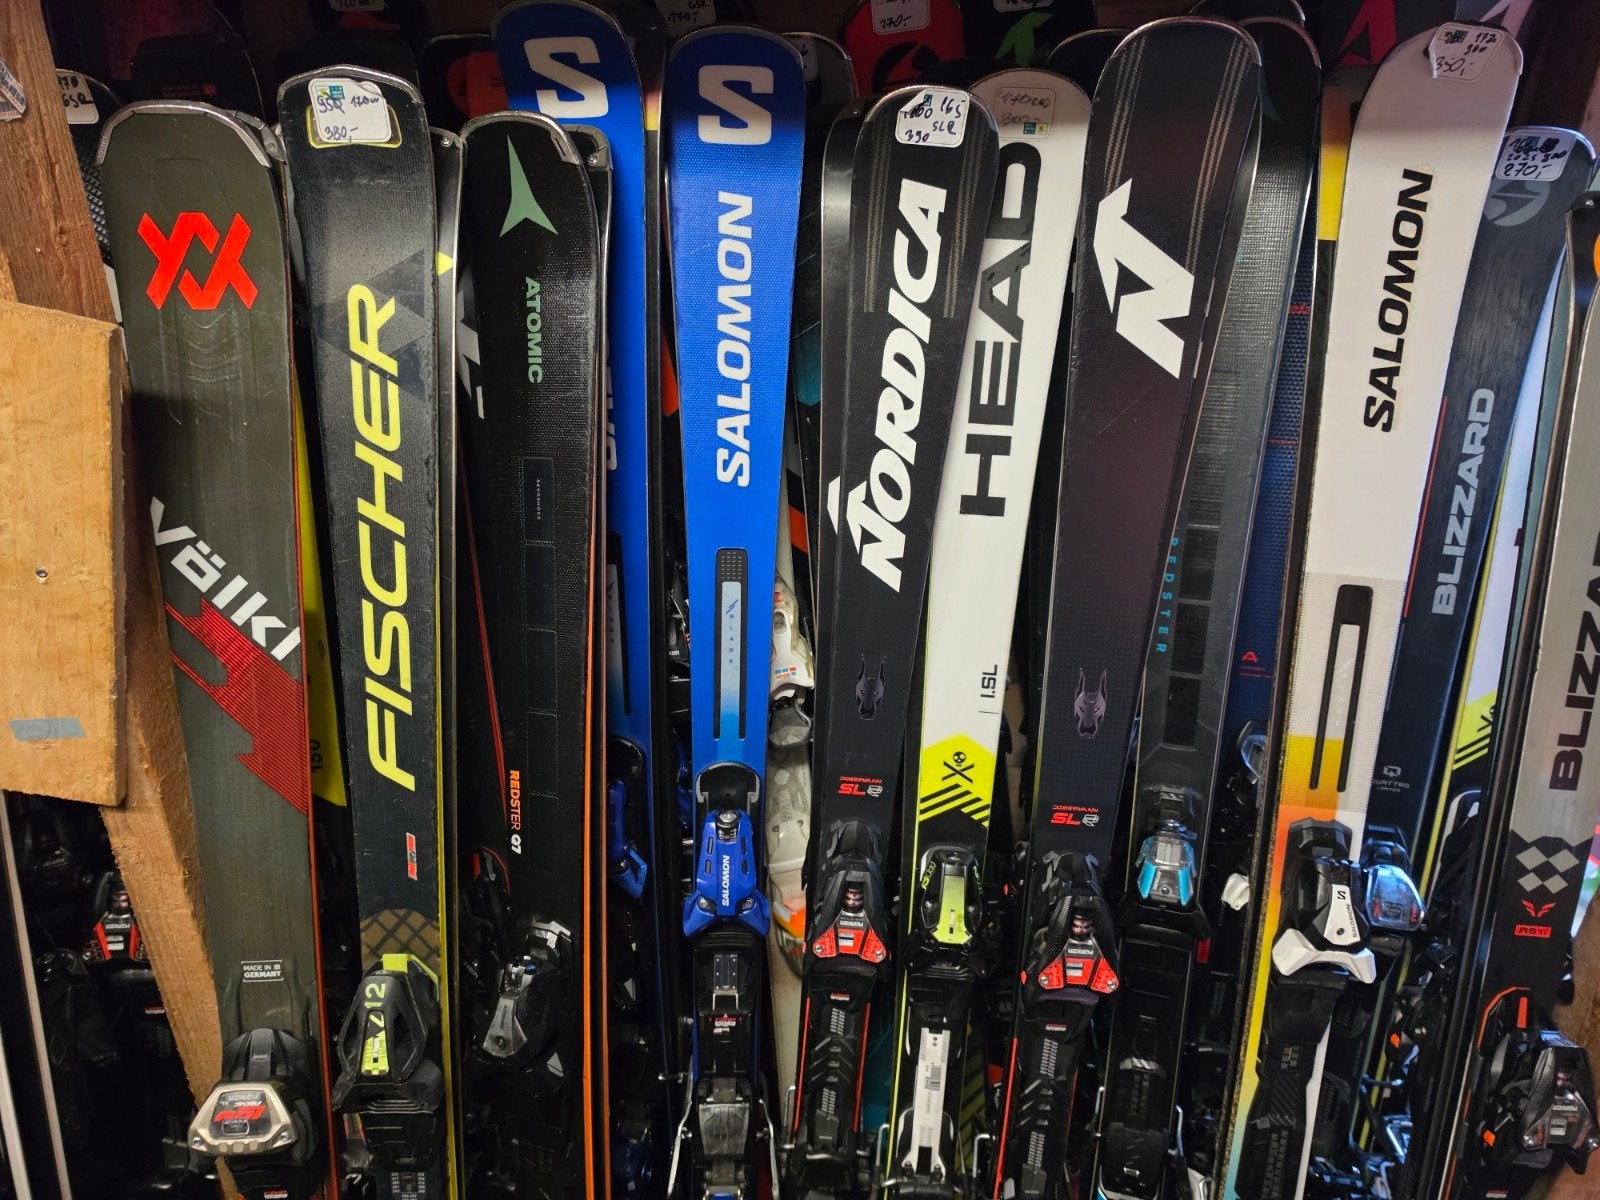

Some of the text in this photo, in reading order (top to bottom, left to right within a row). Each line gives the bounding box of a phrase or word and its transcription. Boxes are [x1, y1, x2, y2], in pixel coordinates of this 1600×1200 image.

[698, 64, 774, 145] S
[525, 276, 543, 384] ATOMIC
[716, 190, 753, 487] SALOMON
[958, 142, 1043, 517] HEAD
[1364, 168, 1434, 433] SALOMON
[846, 178, 947, 593] NORDICA
[346, 284, 417, 791] FISCHER
[1431, 388, 1495, 615] BLIZZARD
[1157, 537, 1179, 653] REDSTER
[1549, 531, 1600, 792] BLIZZ
[510, 769, 522, 831] REDSTER
[838, 783, 866, 796] SL
[1050, 812, 1081, 825] SL
[720, 854, 731, 908] SALOMON
[1345, 903, 1358, 938] SALOMON
[1519, 927, 1537, 935] RS
